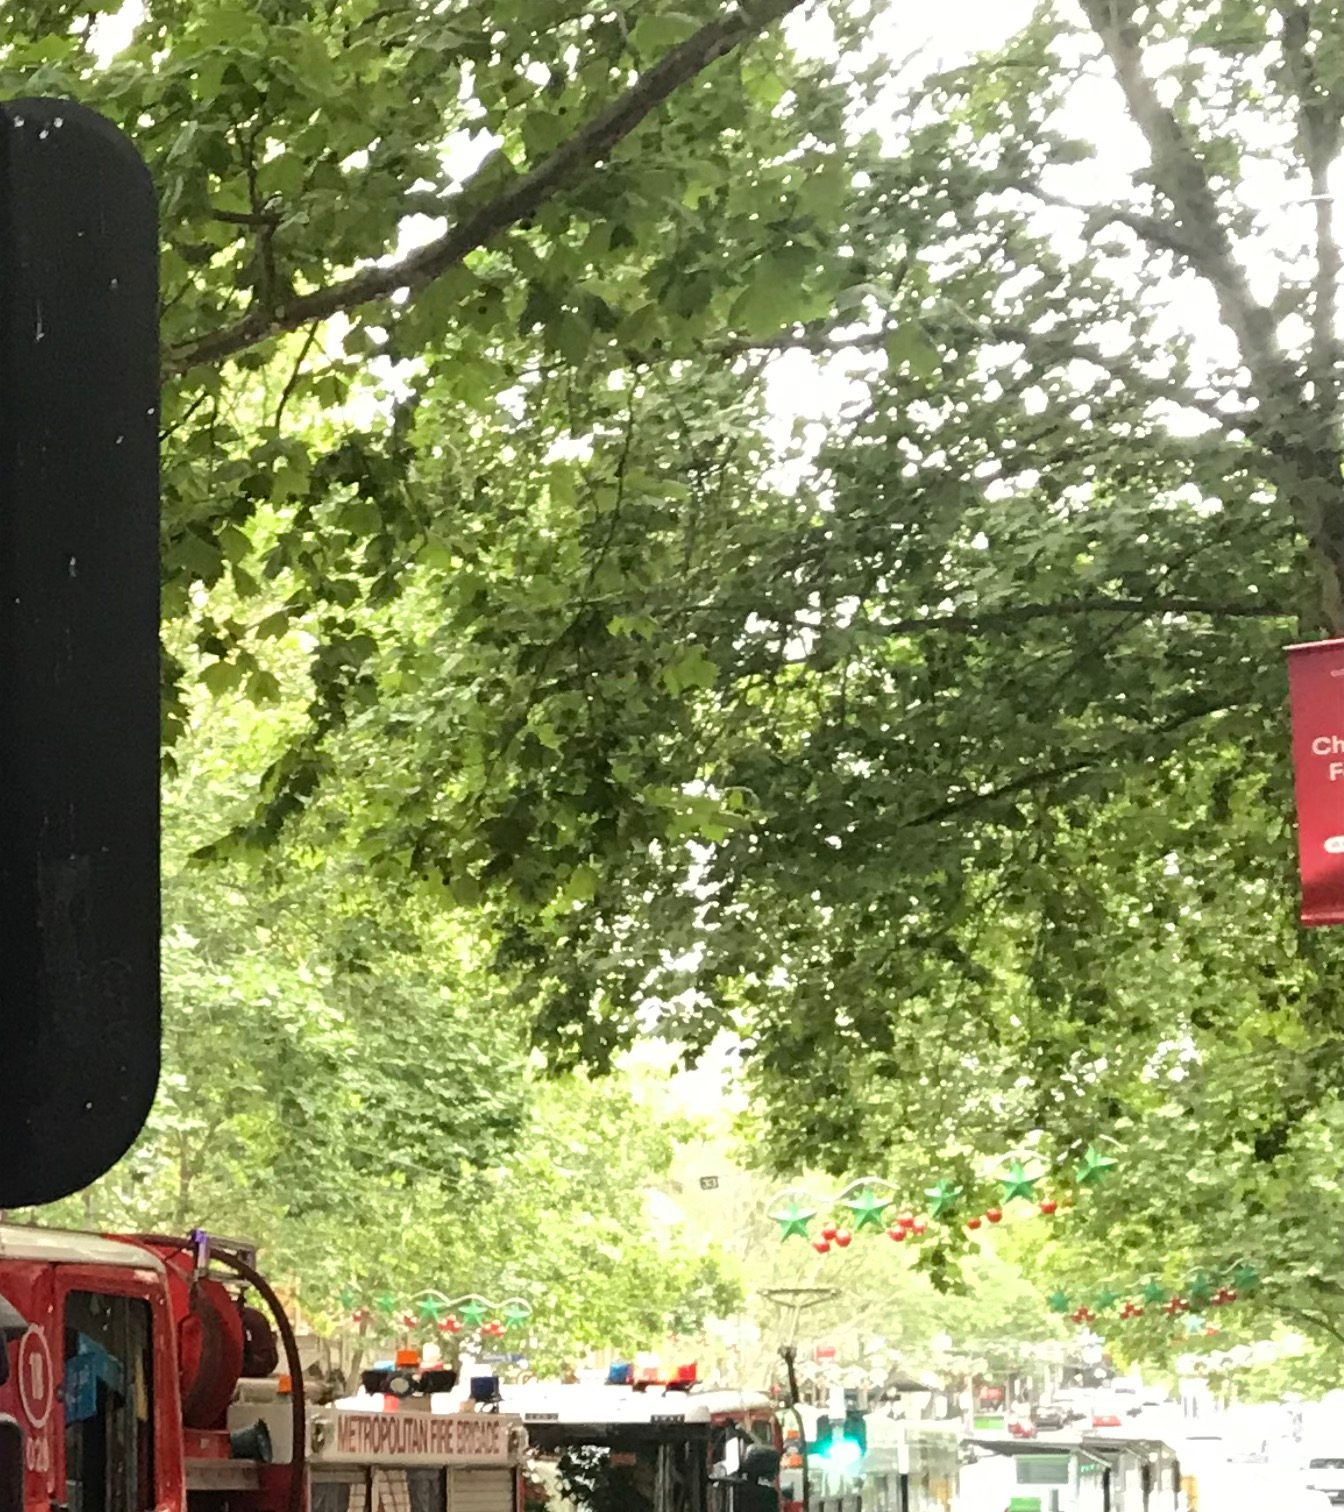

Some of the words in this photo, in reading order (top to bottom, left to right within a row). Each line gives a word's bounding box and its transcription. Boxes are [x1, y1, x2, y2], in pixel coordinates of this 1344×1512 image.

[337, 1414, 428, 1455] METROPOLITAN
[430, 1418, 454, 1454] FIRE
[456, 1419, 500, 1455] BRIGADE
